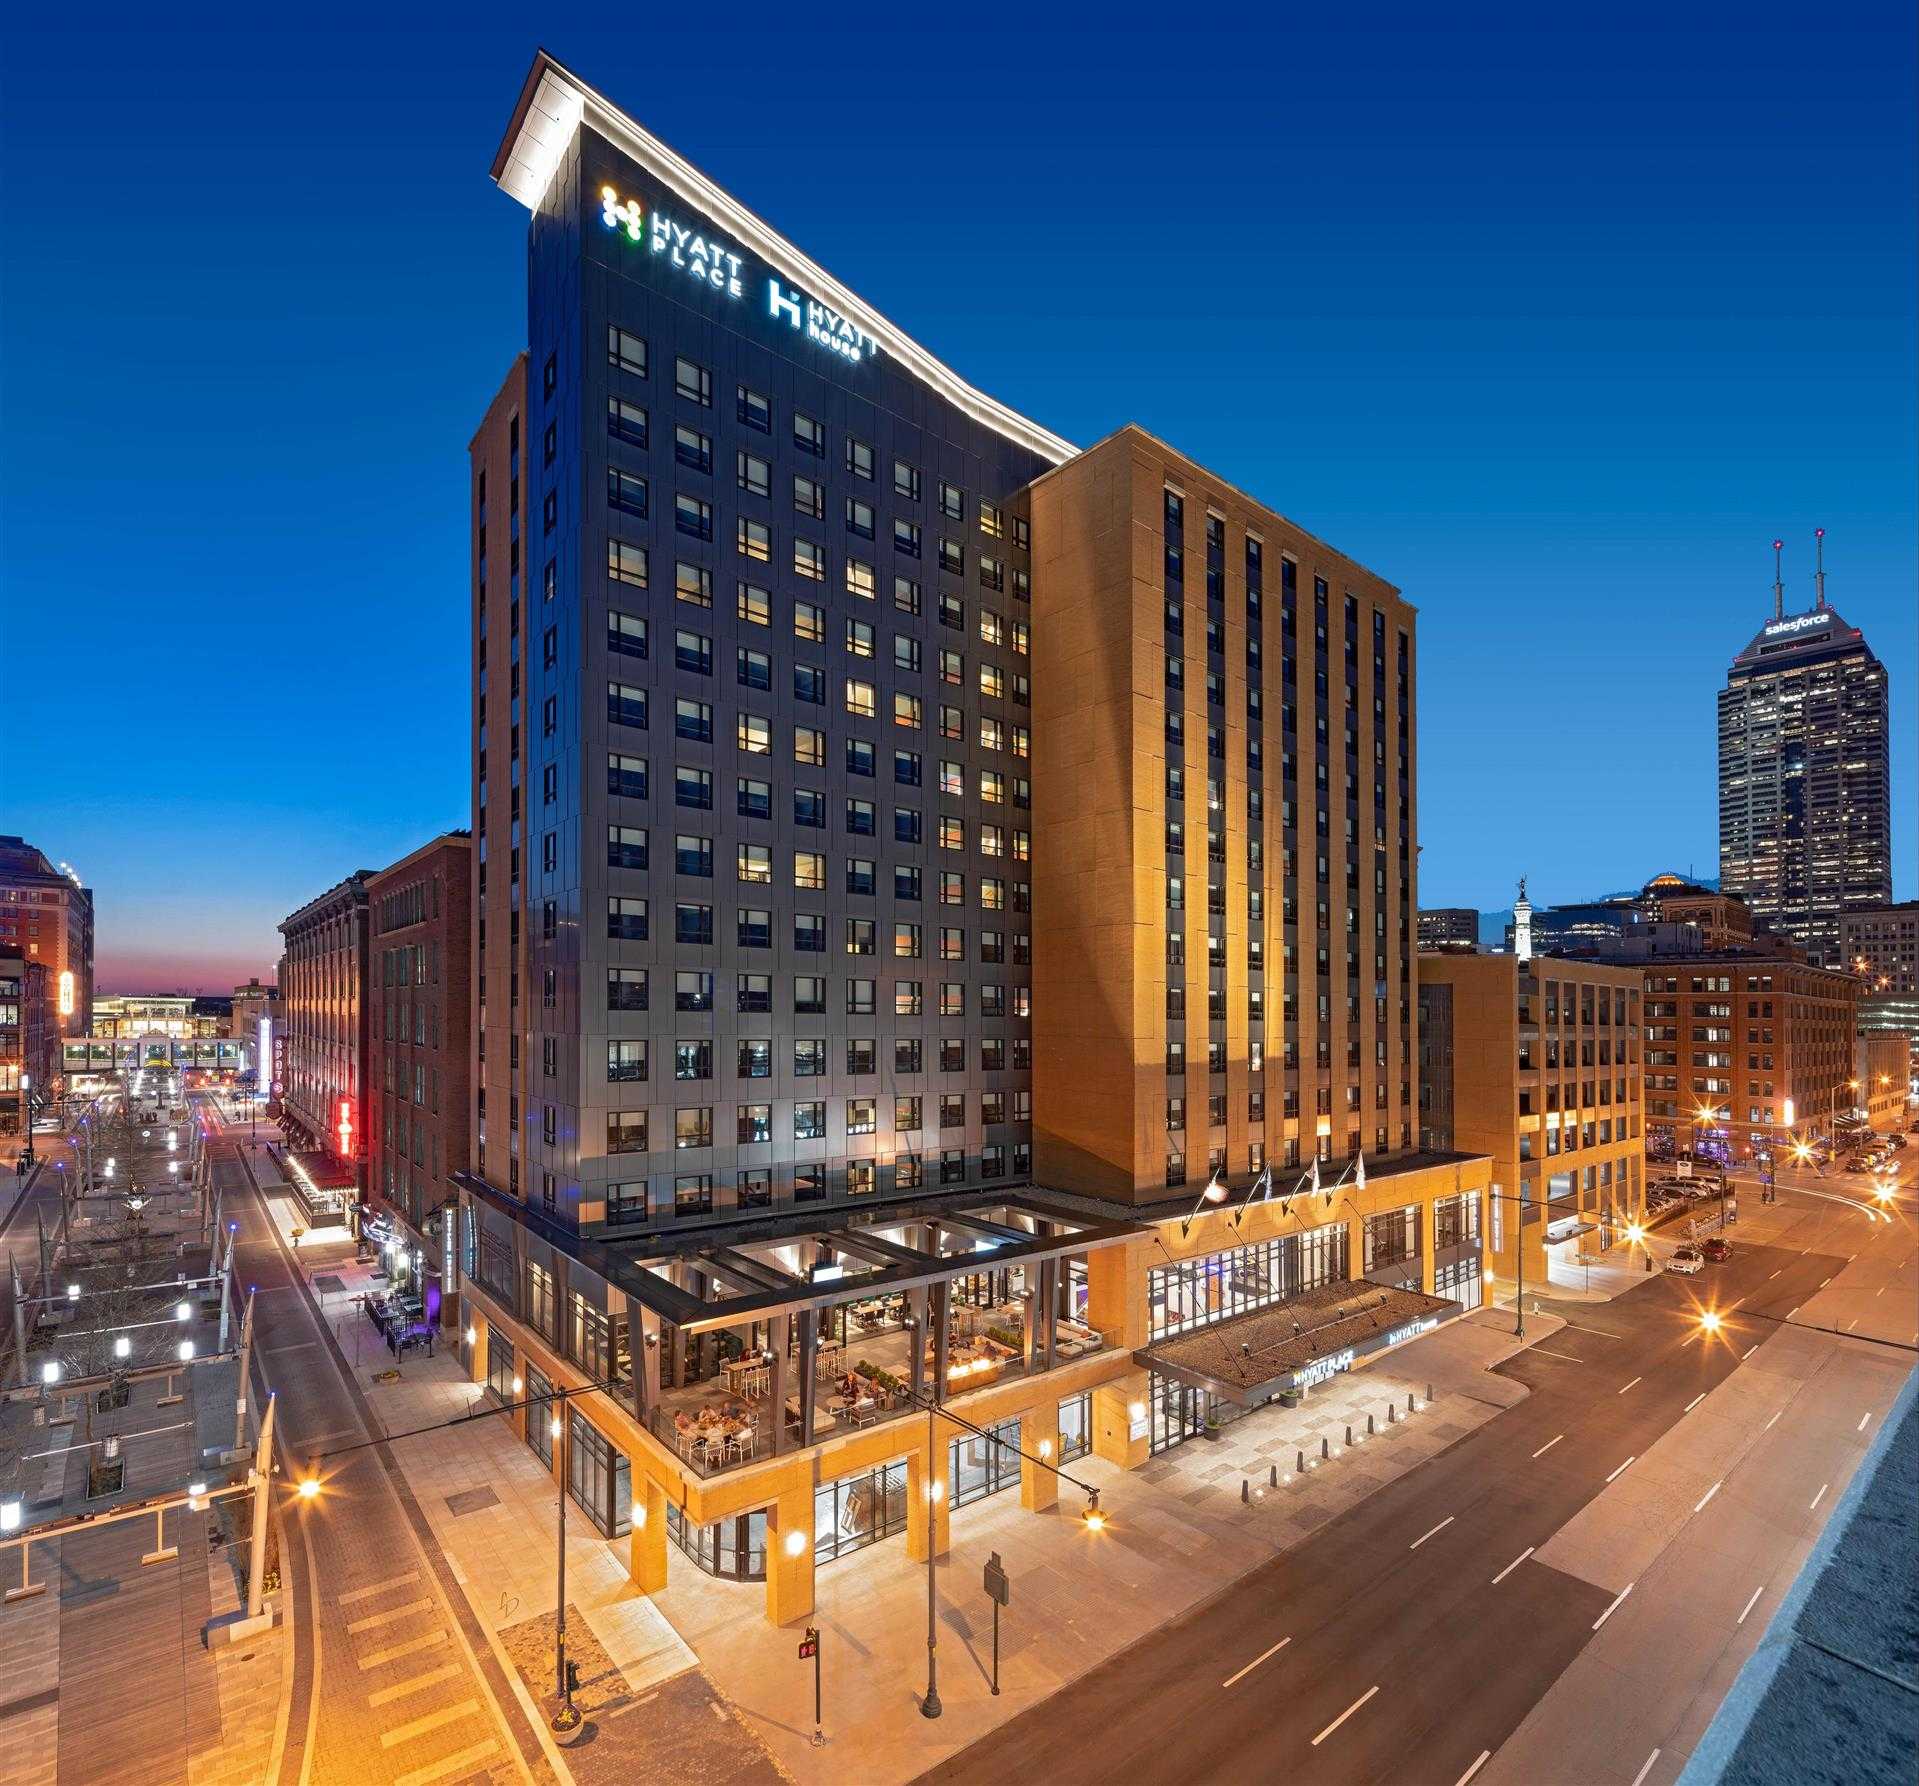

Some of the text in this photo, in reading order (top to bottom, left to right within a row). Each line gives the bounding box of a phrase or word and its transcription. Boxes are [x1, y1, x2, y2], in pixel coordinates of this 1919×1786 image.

[652, 211, 743, 278] HYATT
[652, 234, 743, 298] PLACE
[808, 300, 881, 356] HYATT
[1765, 614, 1831, 636] salesforce
